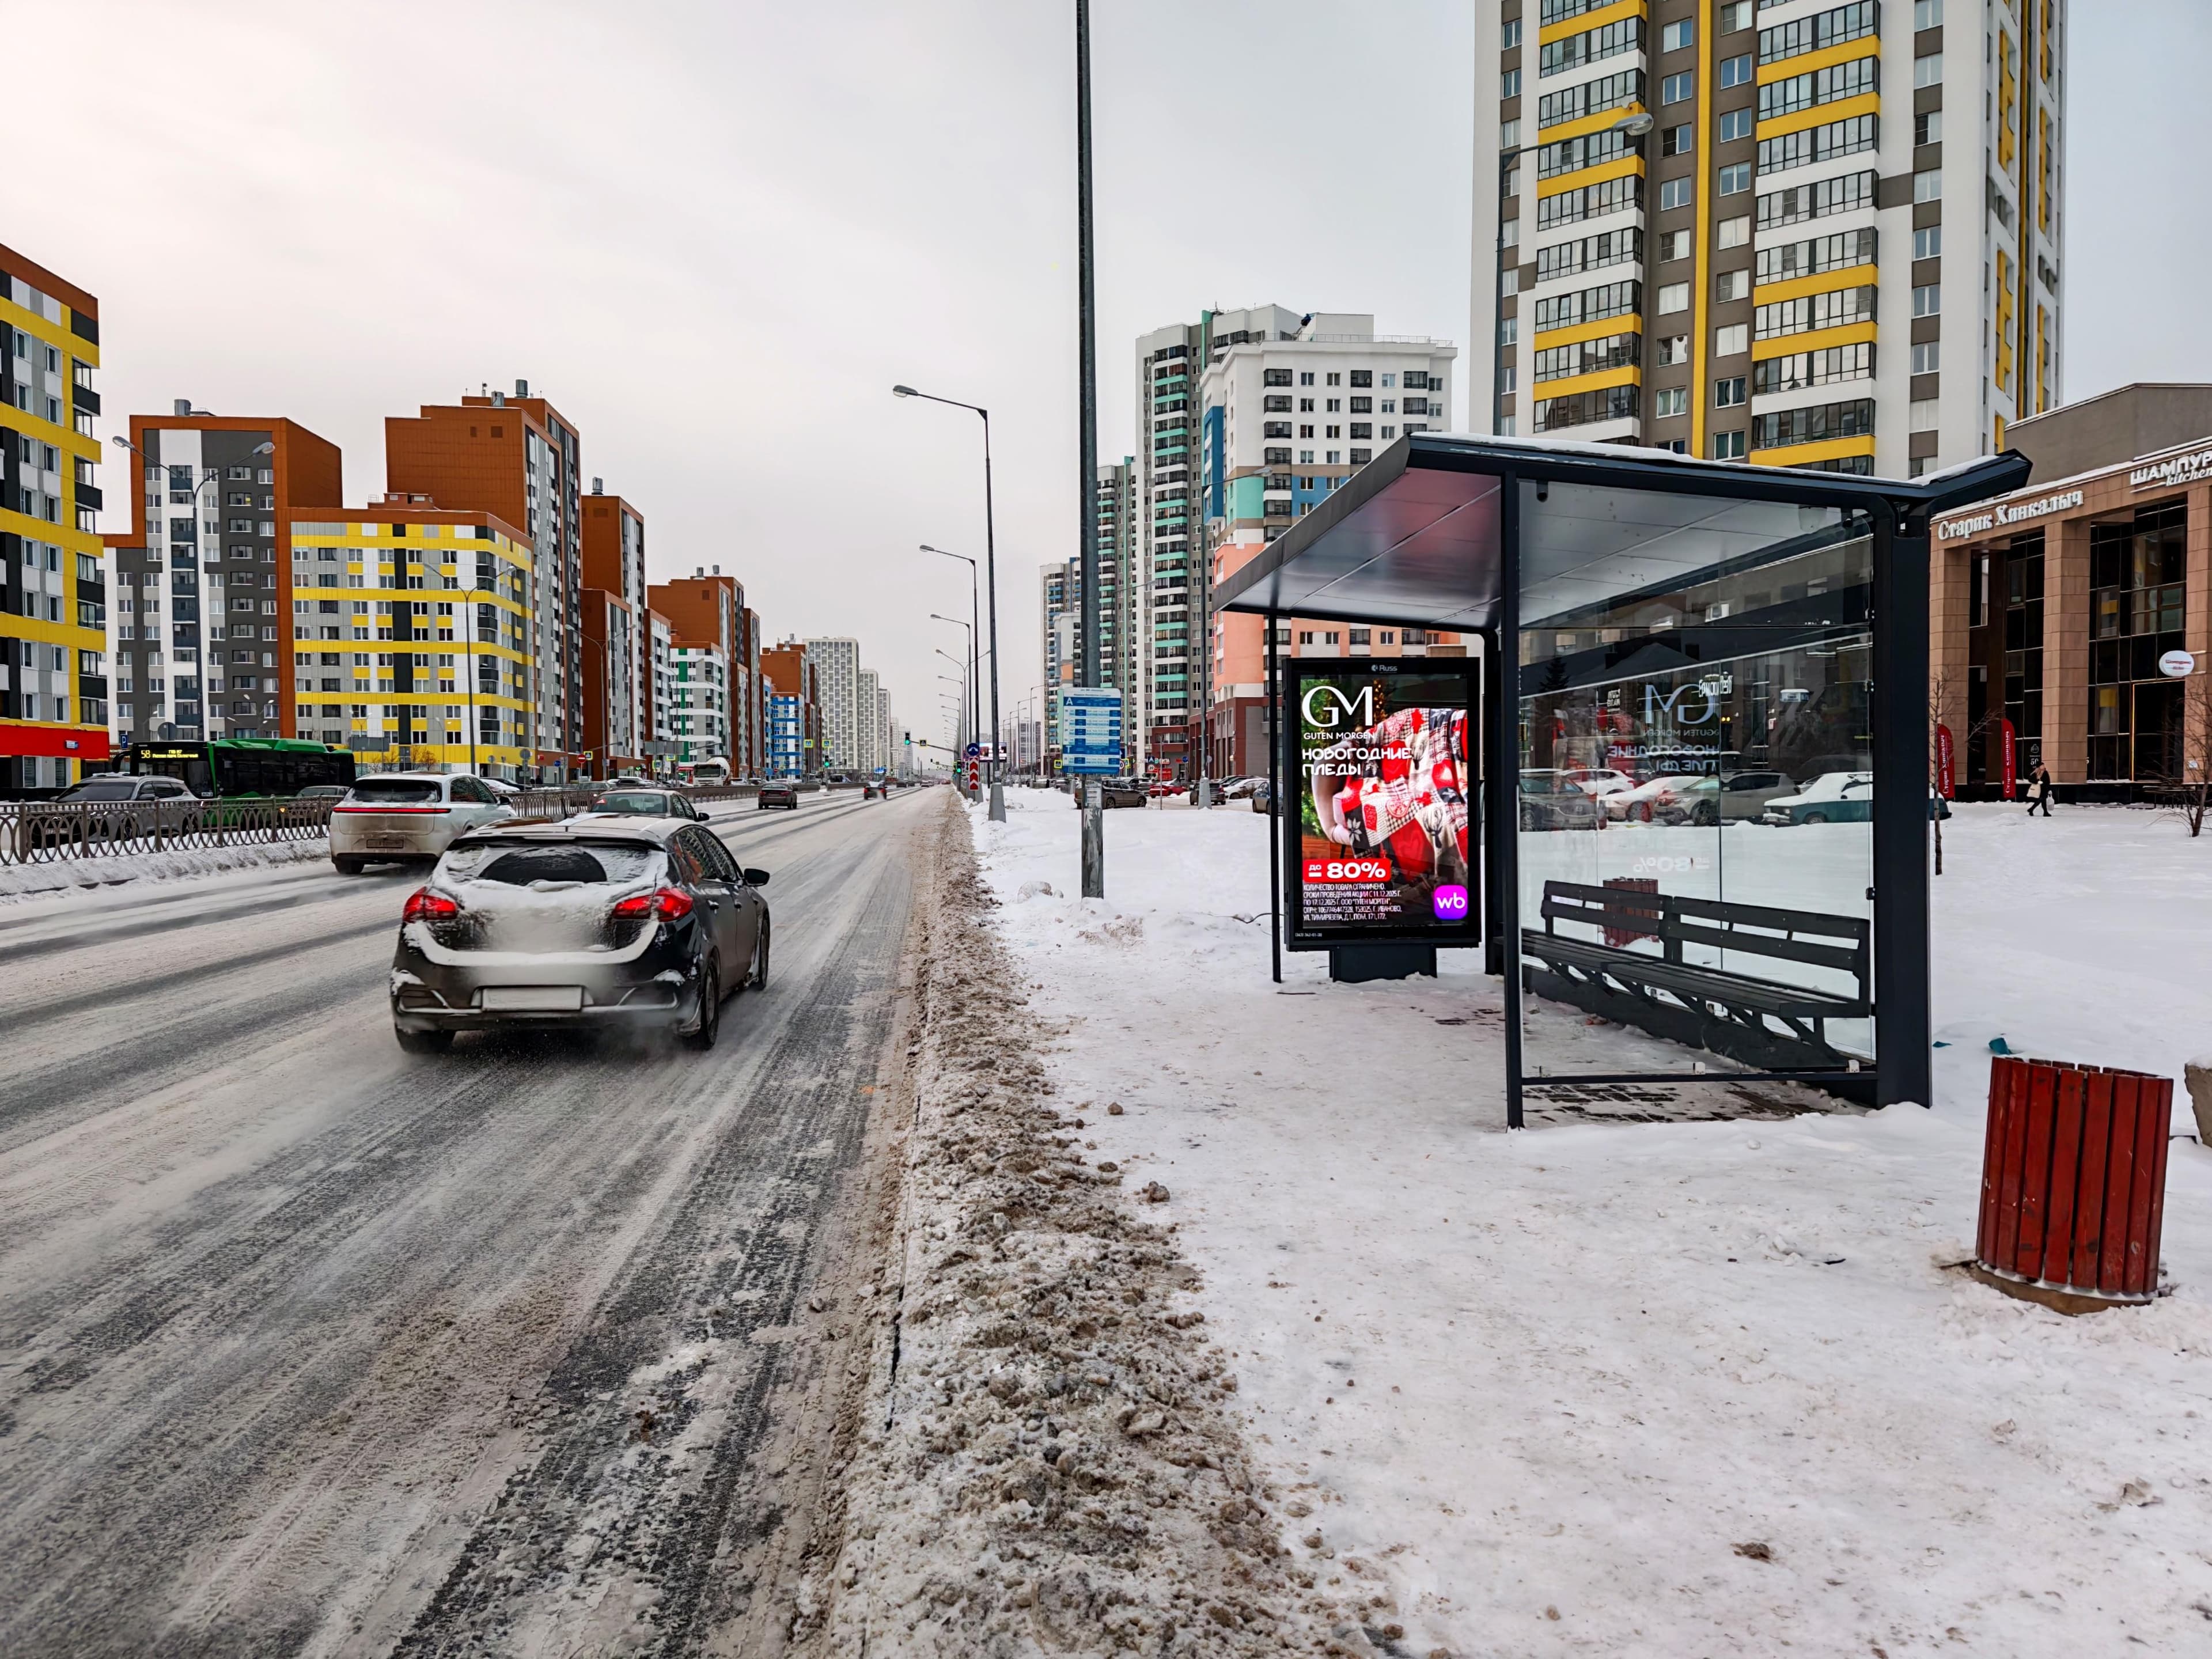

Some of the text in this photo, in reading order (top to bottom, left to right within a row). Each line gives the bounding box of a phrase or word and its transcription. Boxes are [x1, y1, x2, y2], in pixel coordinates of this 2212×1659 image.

[1938, 490, 2084, 540] Старик Хинкалыч
[1302, 685, 1373, 727] GM
[141, 750, 150, 758] 58
[1302, 748, 1412, 760] НОВОГОДНИЕ
[1302, 763, 1361, 776] ПЛЕДЫ
[1437, 892, 1465, 908] wb
